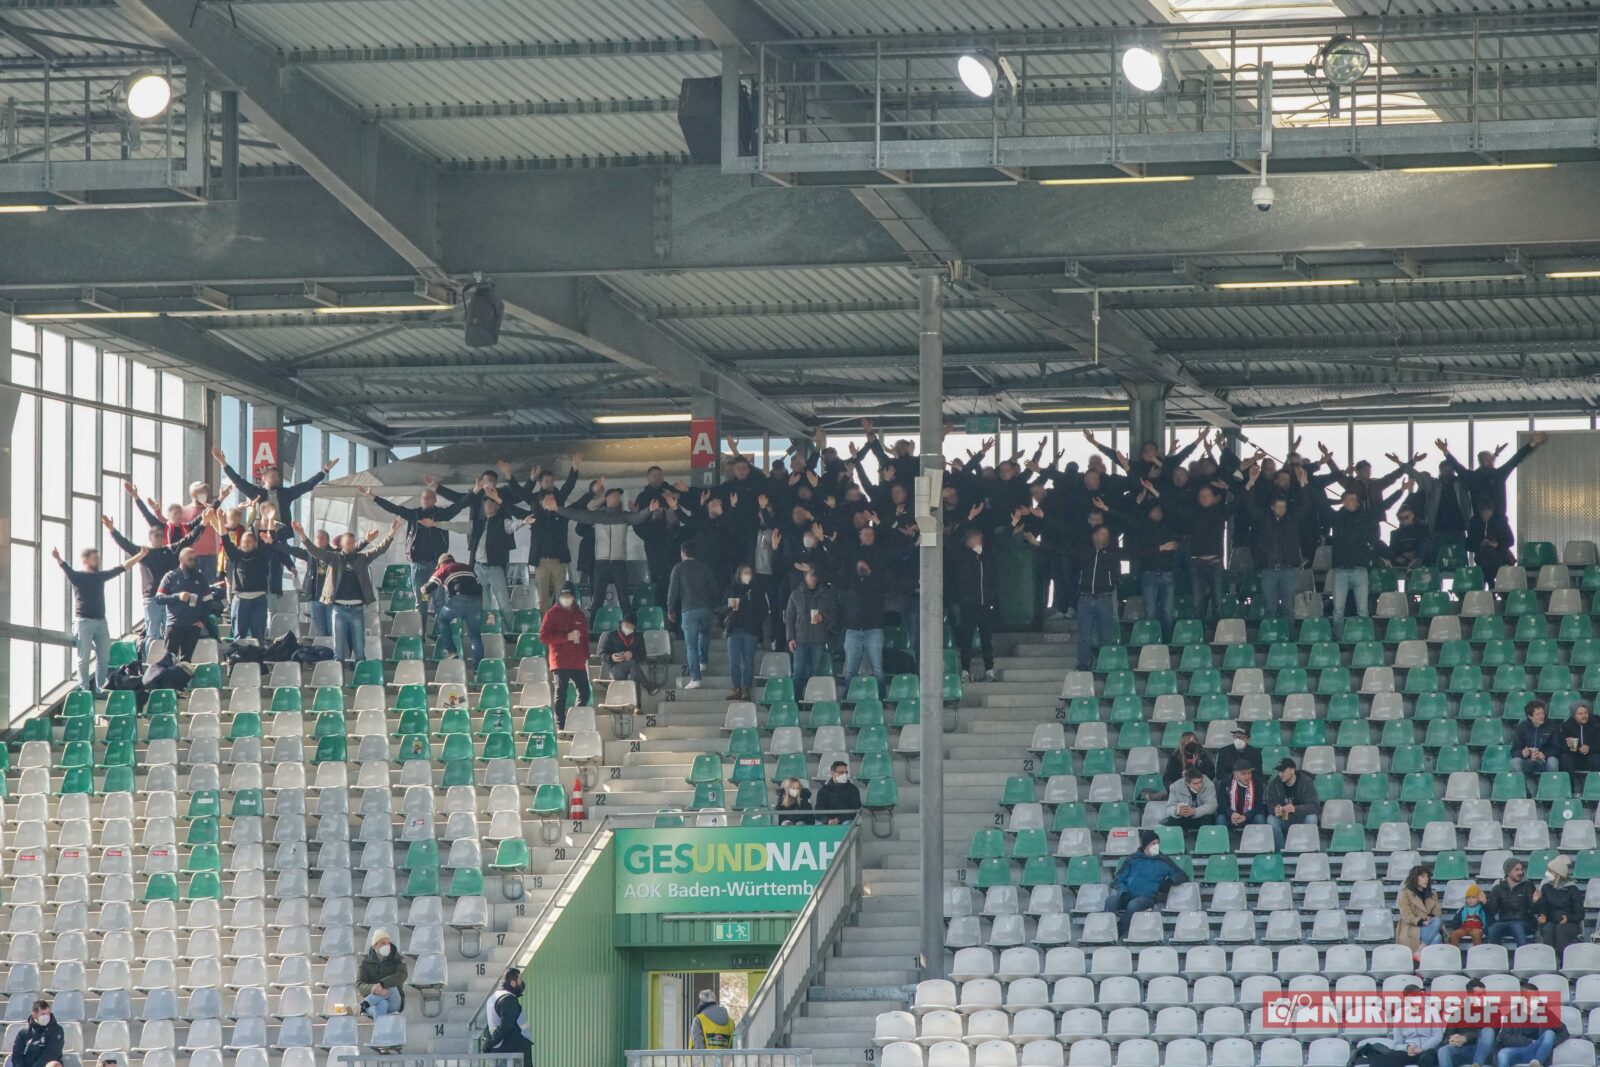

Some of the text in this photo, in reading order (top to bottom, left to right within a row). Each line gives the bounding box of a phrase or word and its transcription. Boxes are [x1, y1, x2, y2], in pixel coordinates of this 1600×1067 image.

[692, 432, 714, 455] A
[254, 442, 276, 465] A
[665, 690, 676, 701] 26
[1055, 708, 1066, 719] 25
[646, 716, 657, 727] 25
[630, 741, 641, 753] 24
[1023, 760, 1034, 771] 23
[610, 768, 621, 779] 23
[595, 794, 606, 806] 22
[994, 814, 1004, 825] 21
[573, 821, 582, 832] 21
[554, 849, 566, 860] 20
[623, 841, 842, 875] GESUNDNAH
[956, 869, 966, 880] 19
[533, 877, 543, 888] 19
[623, 883, 662, 899] AOK
[515, 904, 525, 916] 18
[496, 934, 506, 946] 17
[475, 963, 486, 976] 16
[455, 993, 466, 1006] 15
[434, 1024, 445, 1036] 14
[864, 1048, 875, 1061] 13
